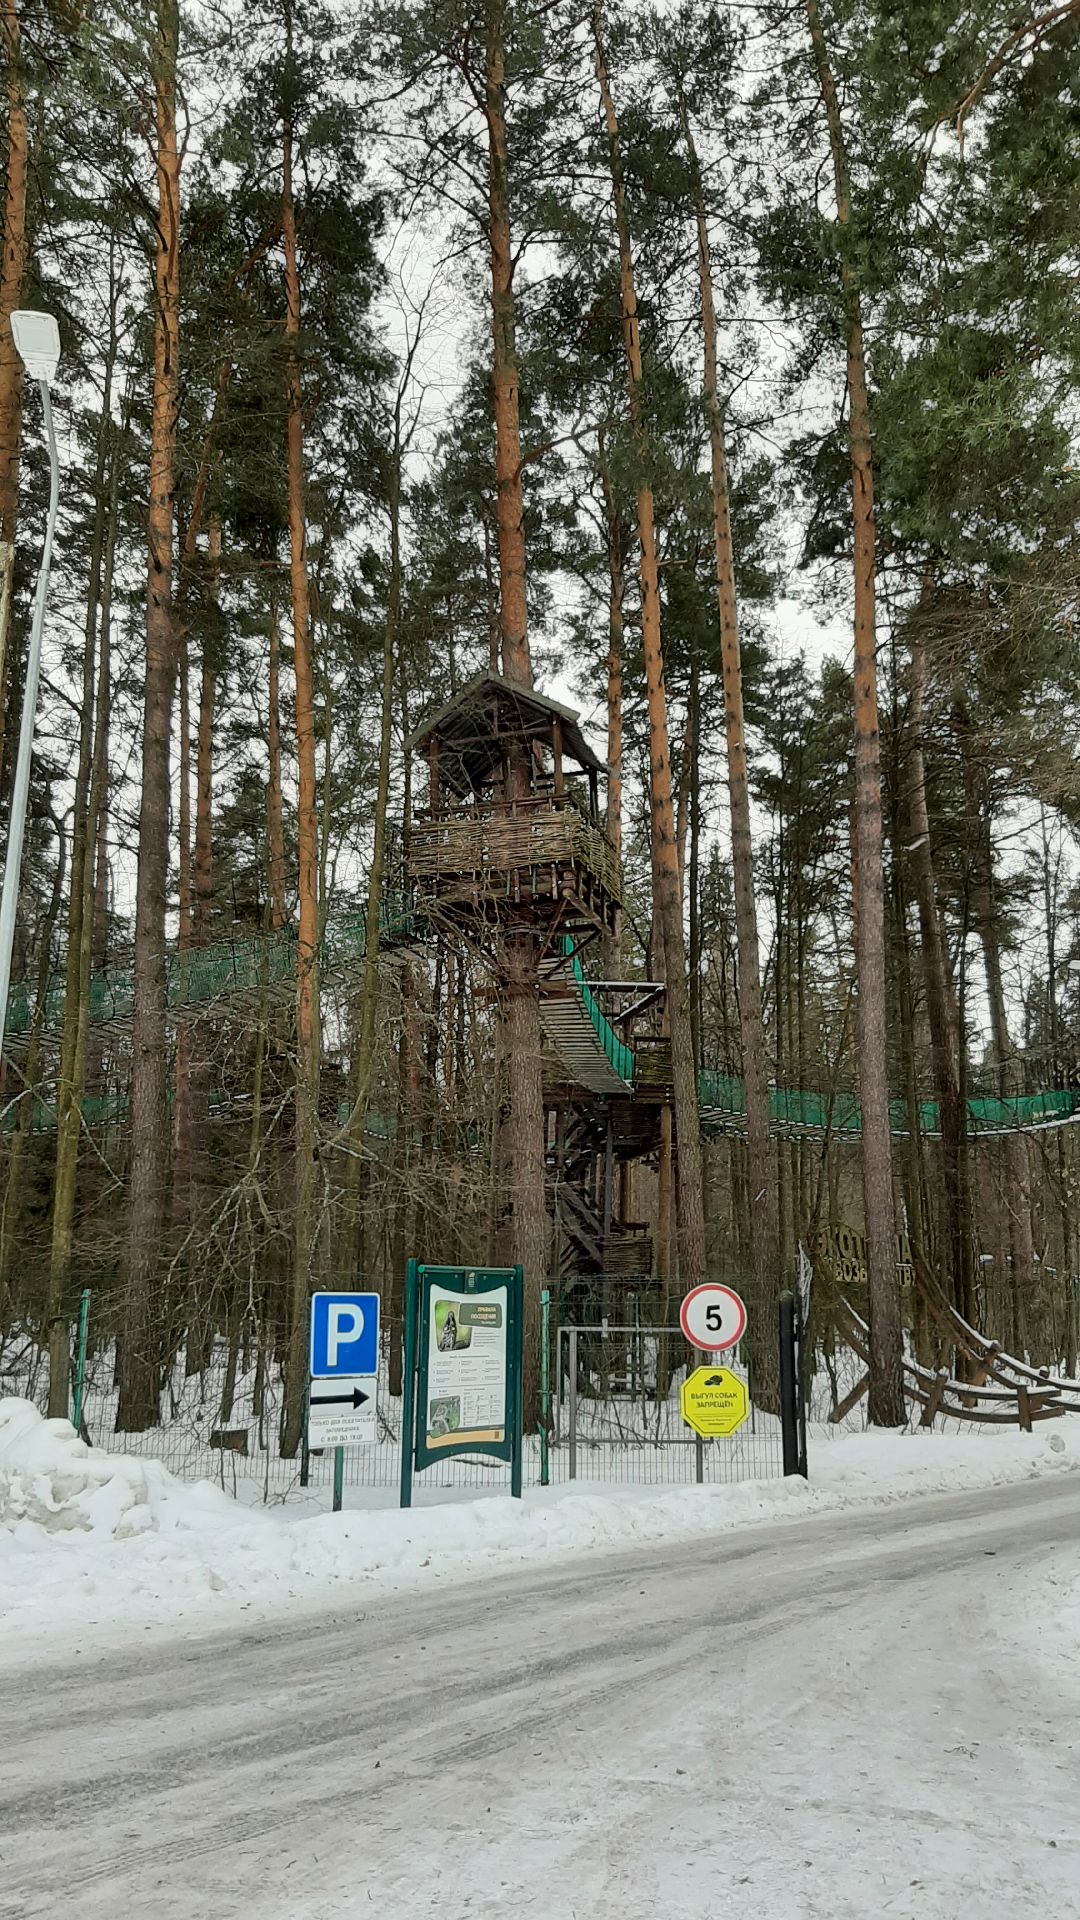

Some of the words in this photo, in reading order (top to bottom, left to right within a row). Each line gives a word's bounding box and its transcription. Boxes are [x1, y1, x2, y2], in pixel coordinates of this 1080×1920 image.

[705, 1304, 722, 1332] 5
[326, 1303, 365, 1367] P
[690, 1392, 714, 1400] ВЫГУЛ
[714, 1391, 738, 1399] СОБАК
